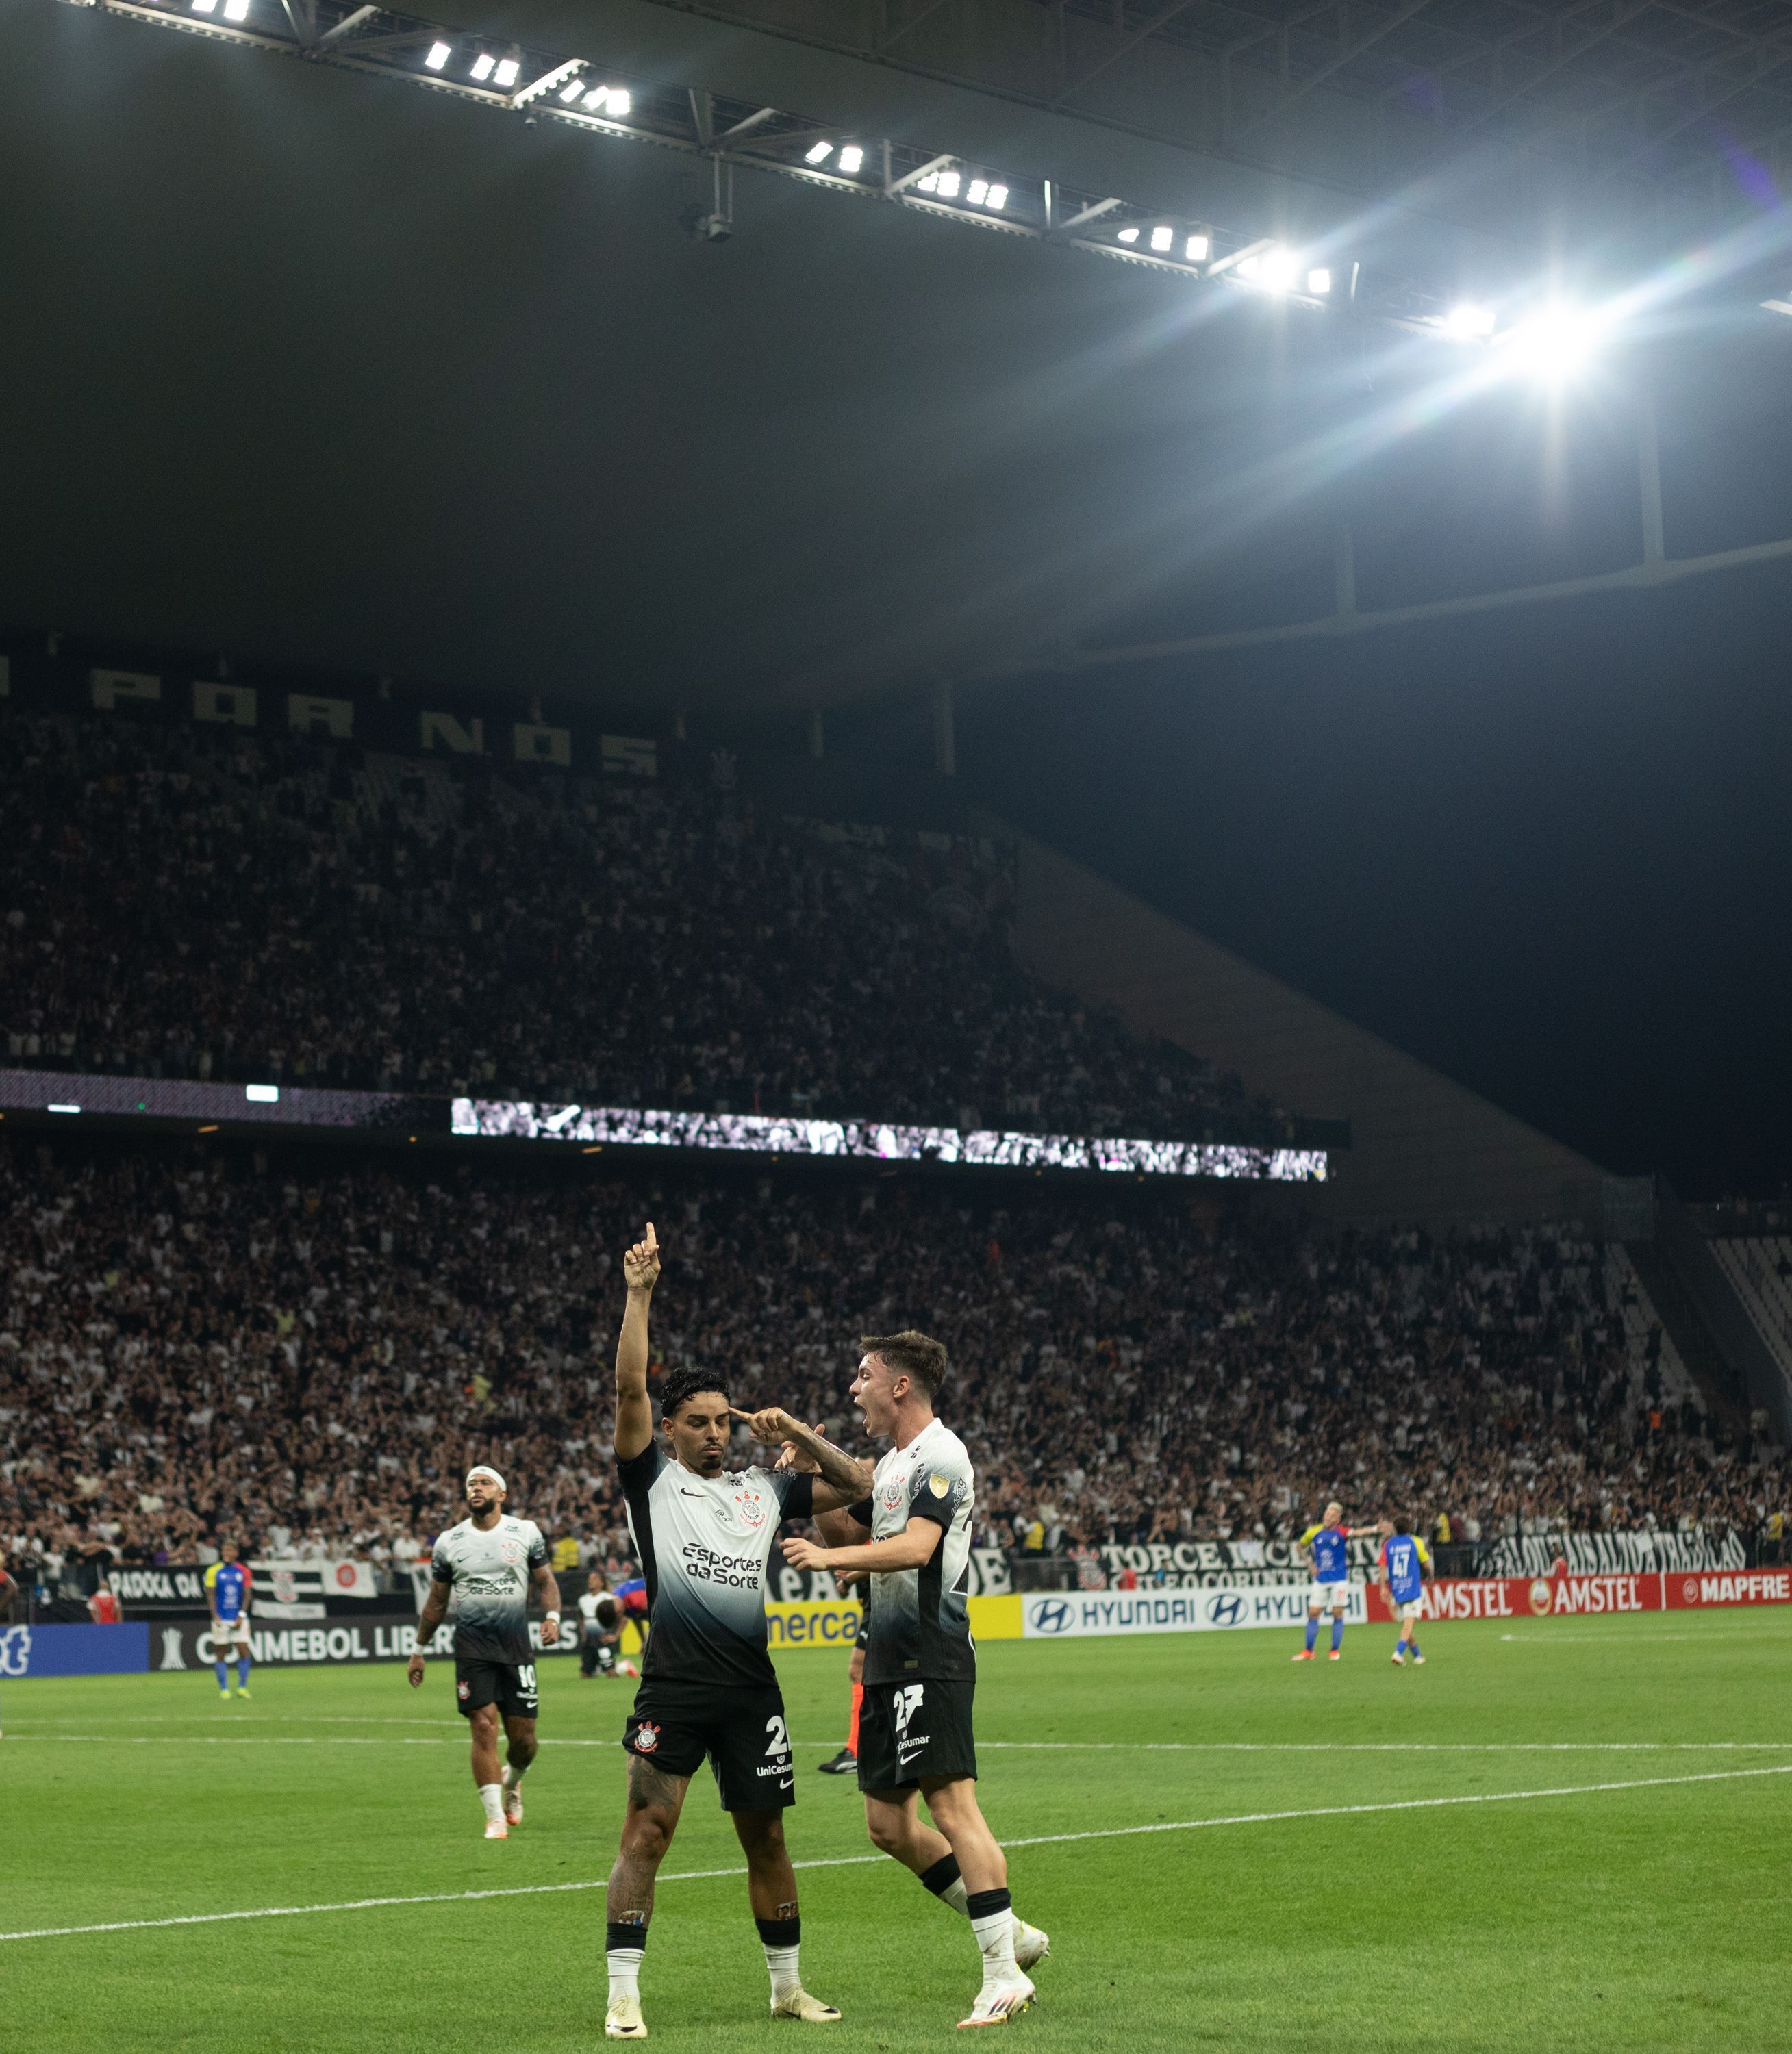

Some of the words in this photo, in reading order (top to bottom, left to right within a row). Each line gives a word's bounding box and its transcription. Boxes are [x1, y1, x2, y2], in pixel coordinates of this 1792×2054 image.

[682, 1542, 762, 1572] Esportes
[1420, 1581, 1513, 1621] AMSTEL
[1554, 1575, 1643, 1614] AMSTEL
[1700, 1573, 1791, 1603] MAPFRE
[1082, 1599, 1195, 1627] HYUNDAI
[518, 1664, 537, 1688] 10
[893, 1684, 924, 1733] 27
[764, 1714, 792, 1756] 2
